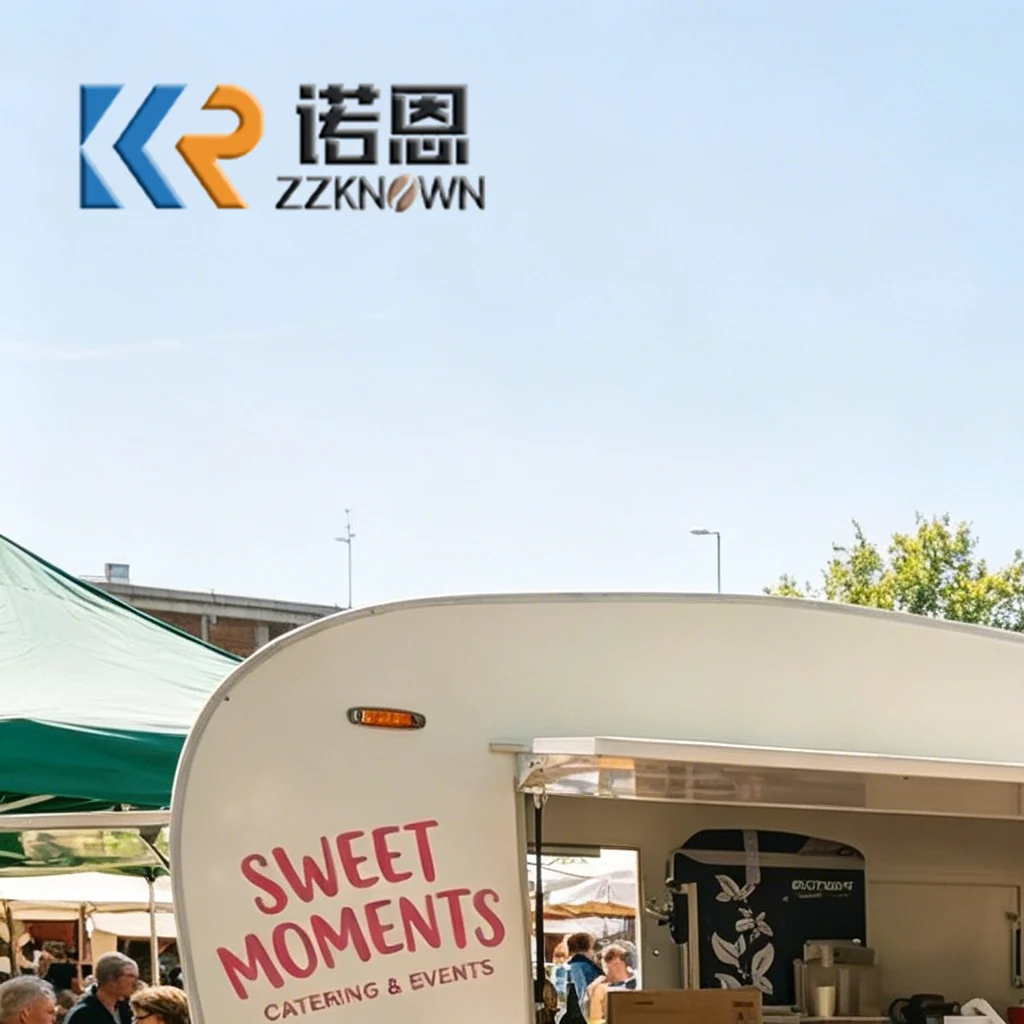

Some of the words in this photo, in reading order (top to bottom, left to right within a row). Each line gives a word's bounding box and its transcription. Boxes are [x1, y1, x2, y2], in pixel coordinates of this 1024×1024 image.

[241, 819, 439, 915] SWEET
[216, 888, 506, 1000] MOMENTS
[263, 982, 380, 1022] CATERING
[387, 977, 402, 995] &
[408, 959, 495, 991] EVENTS
